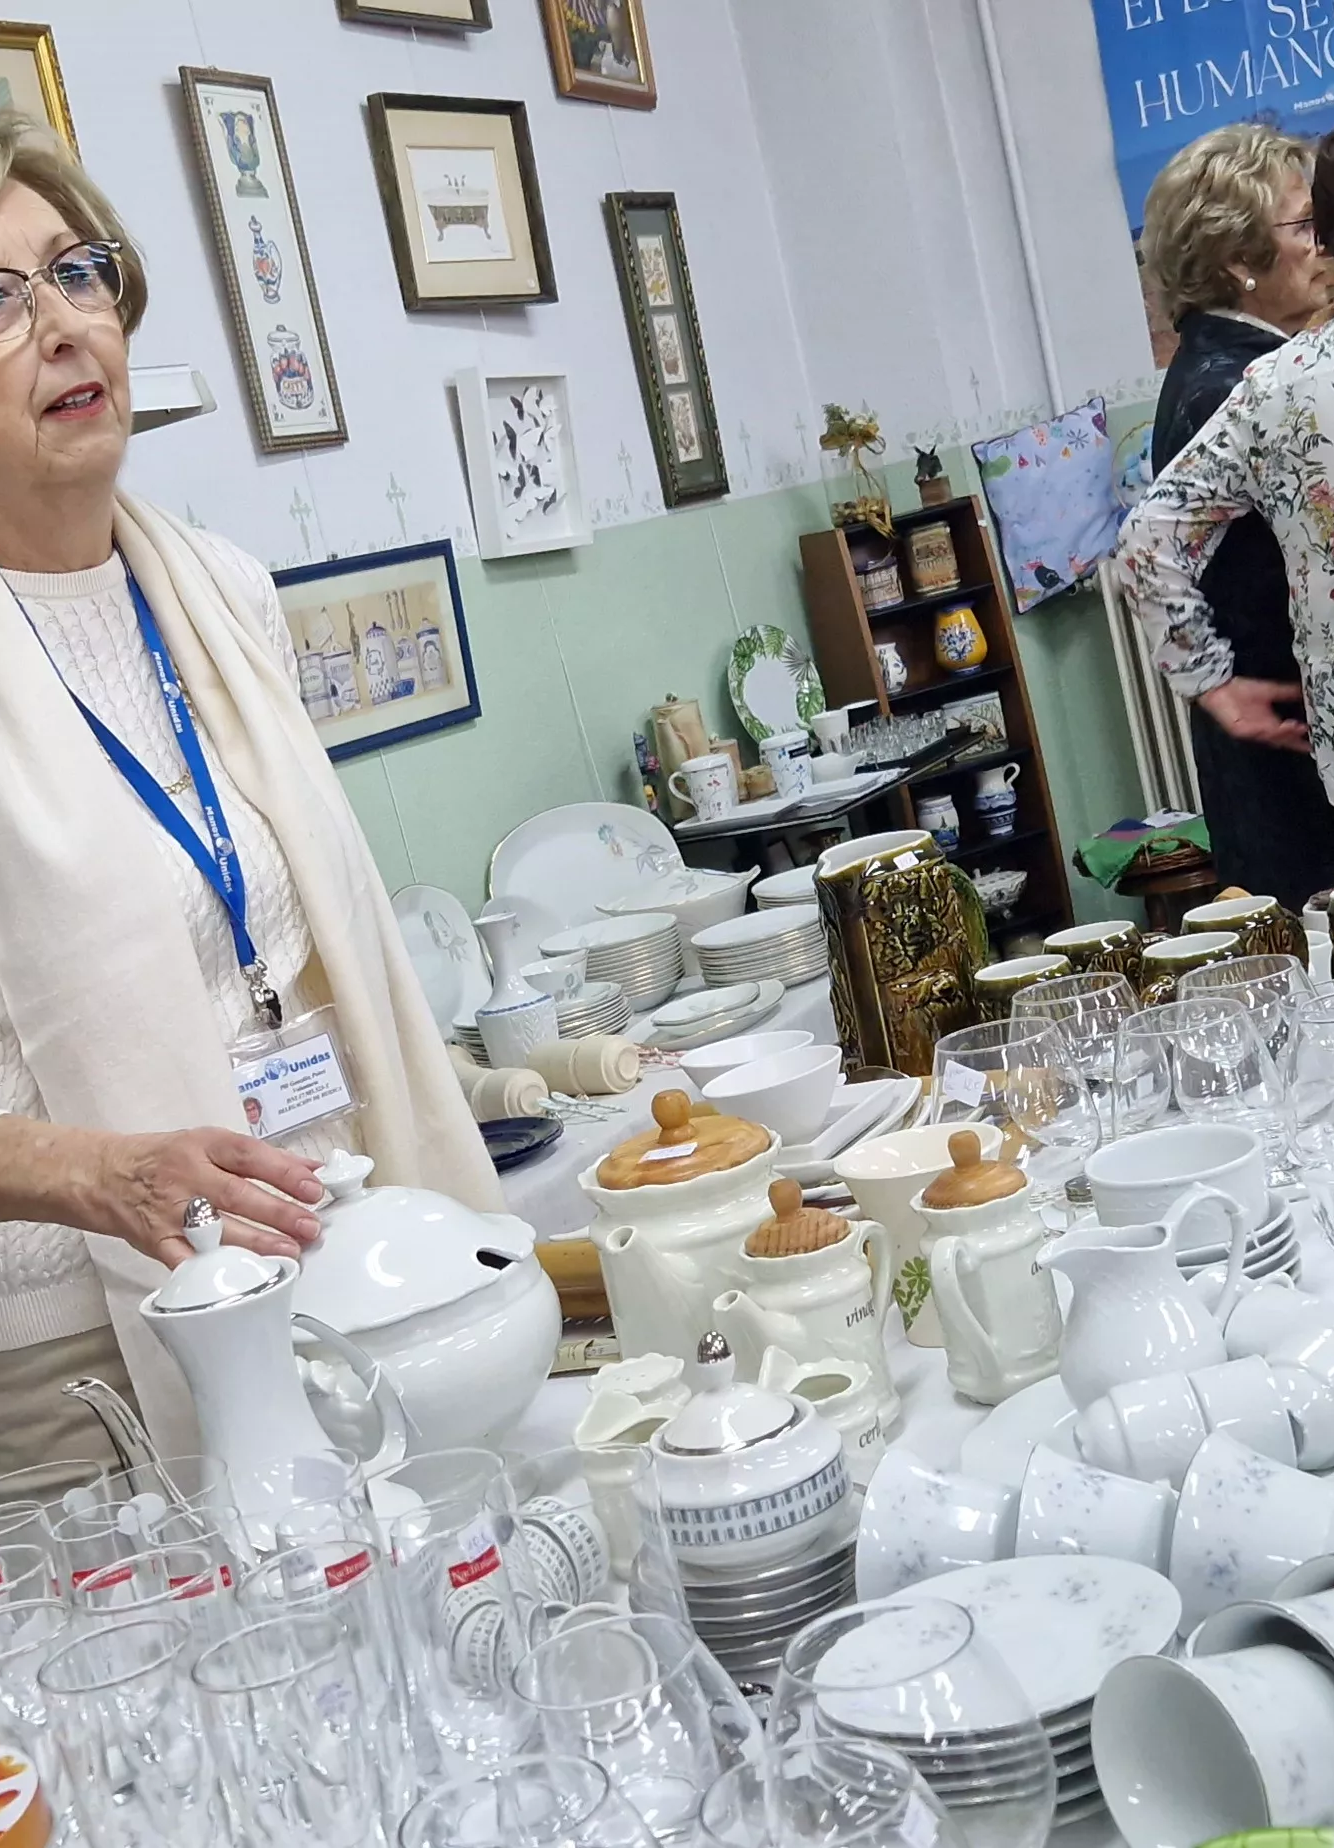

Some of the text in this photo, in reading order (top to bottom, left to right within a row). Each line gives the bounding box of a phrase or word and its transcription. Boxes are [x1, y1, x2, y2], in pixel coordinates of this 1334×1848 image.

[152, 652, 183, 734] Manos Unidas
[205, 806, 233, 894] Manos Unidas
[238, 1076, 267, 1094] anos
[289, 1051, 331, 1073] Unidas
